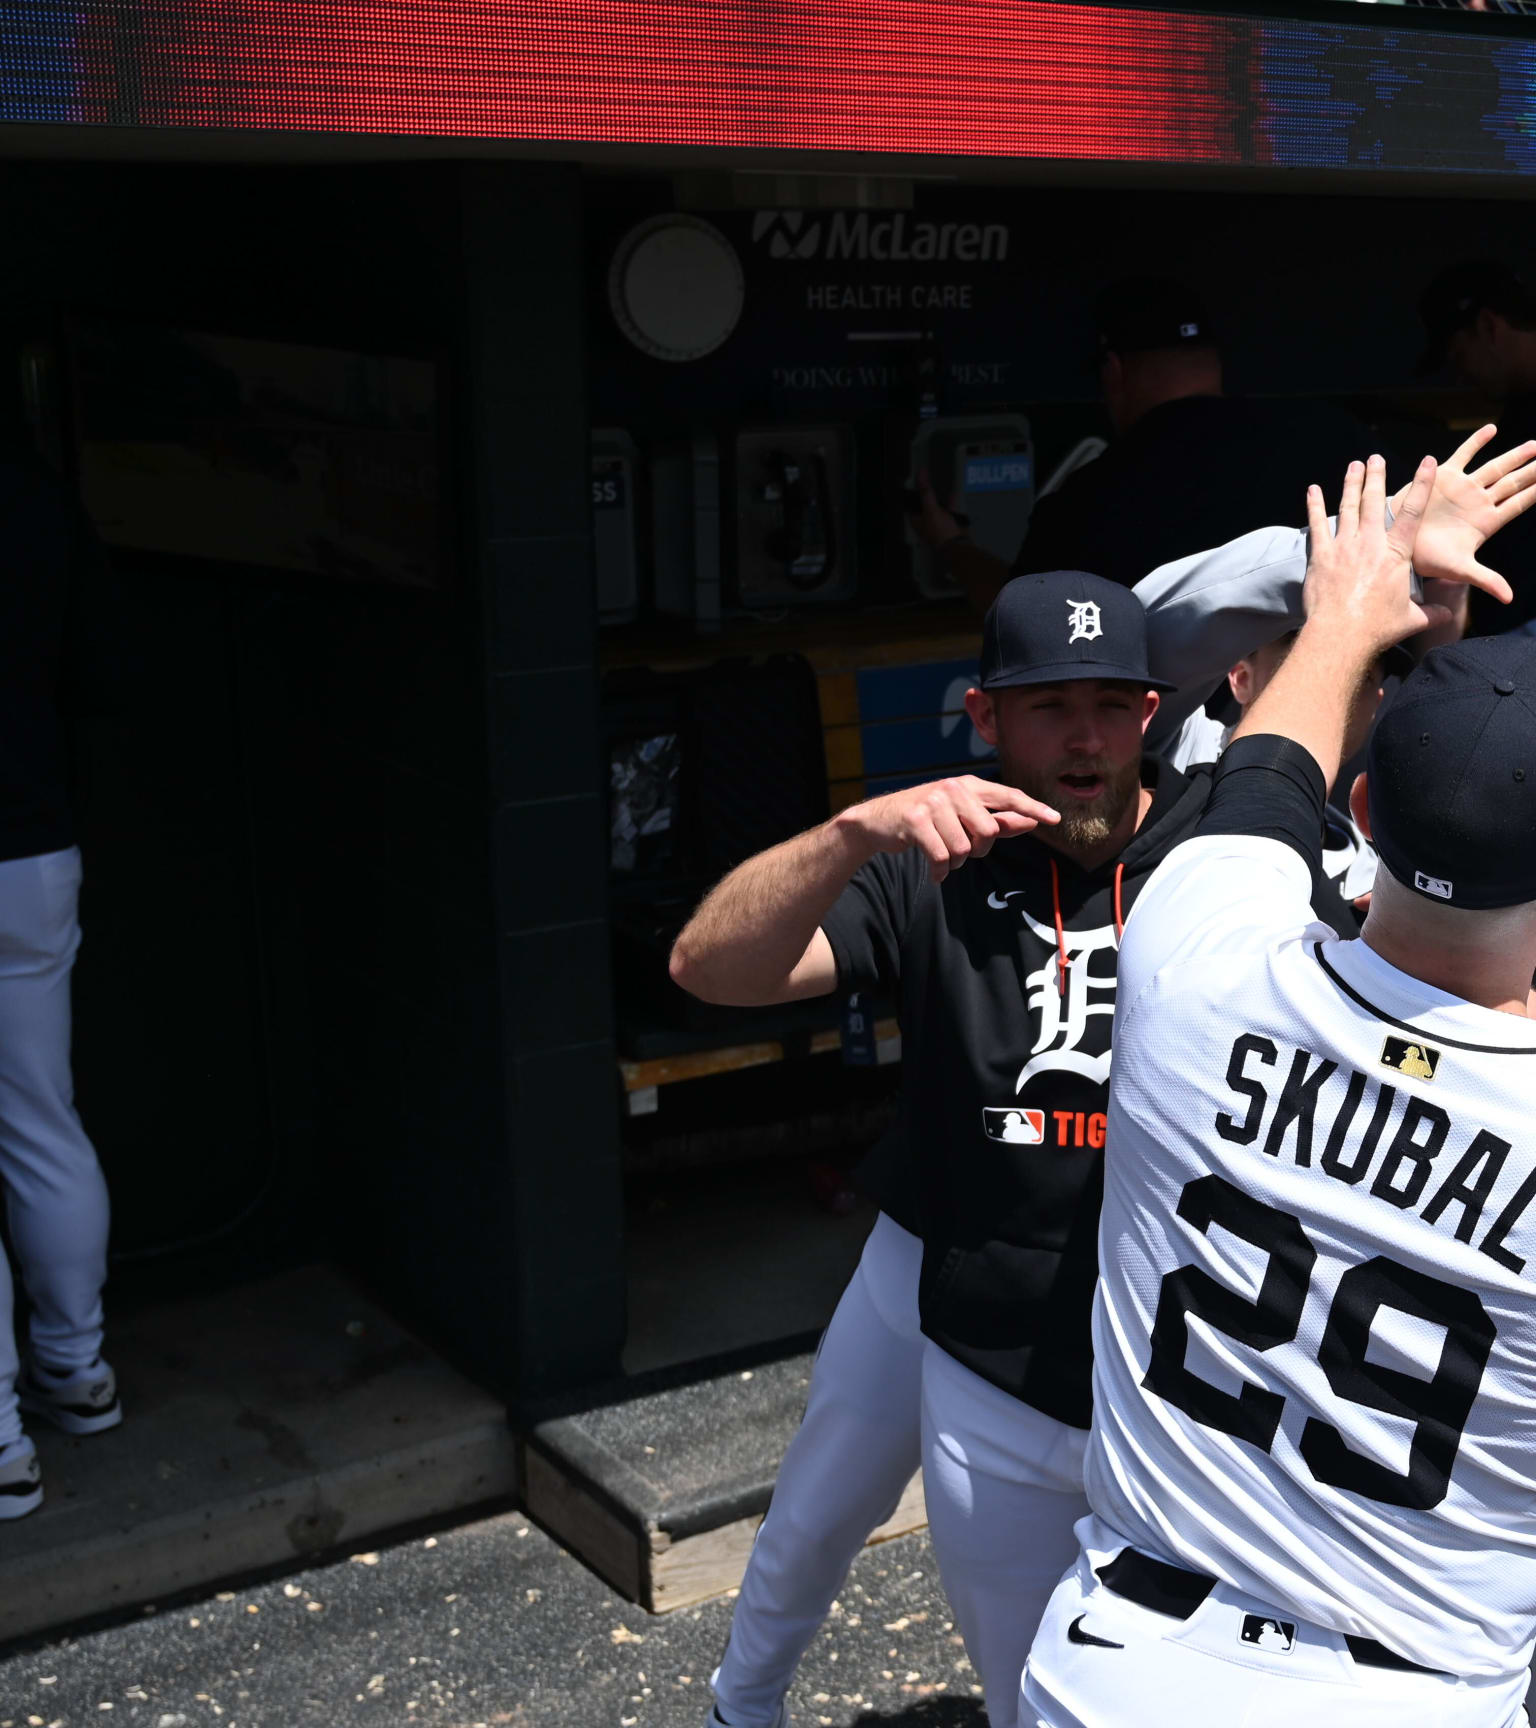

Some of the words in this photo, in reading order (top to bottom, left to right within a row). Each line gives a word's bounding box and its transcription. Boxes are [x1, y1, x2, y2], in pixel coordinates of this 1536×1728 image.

[825, 213, 1009, 262] McLaren
[806, 284, 902, 310] HEALTH
[910, 285, 974, 310] CARE
[966, 463, 1029, 485] BULLPEN
[1066, 599, 1104, 645] D
[1052, 1110, 1107, 1149] TIG
[1141, 1172, 1498, 1512] 29
